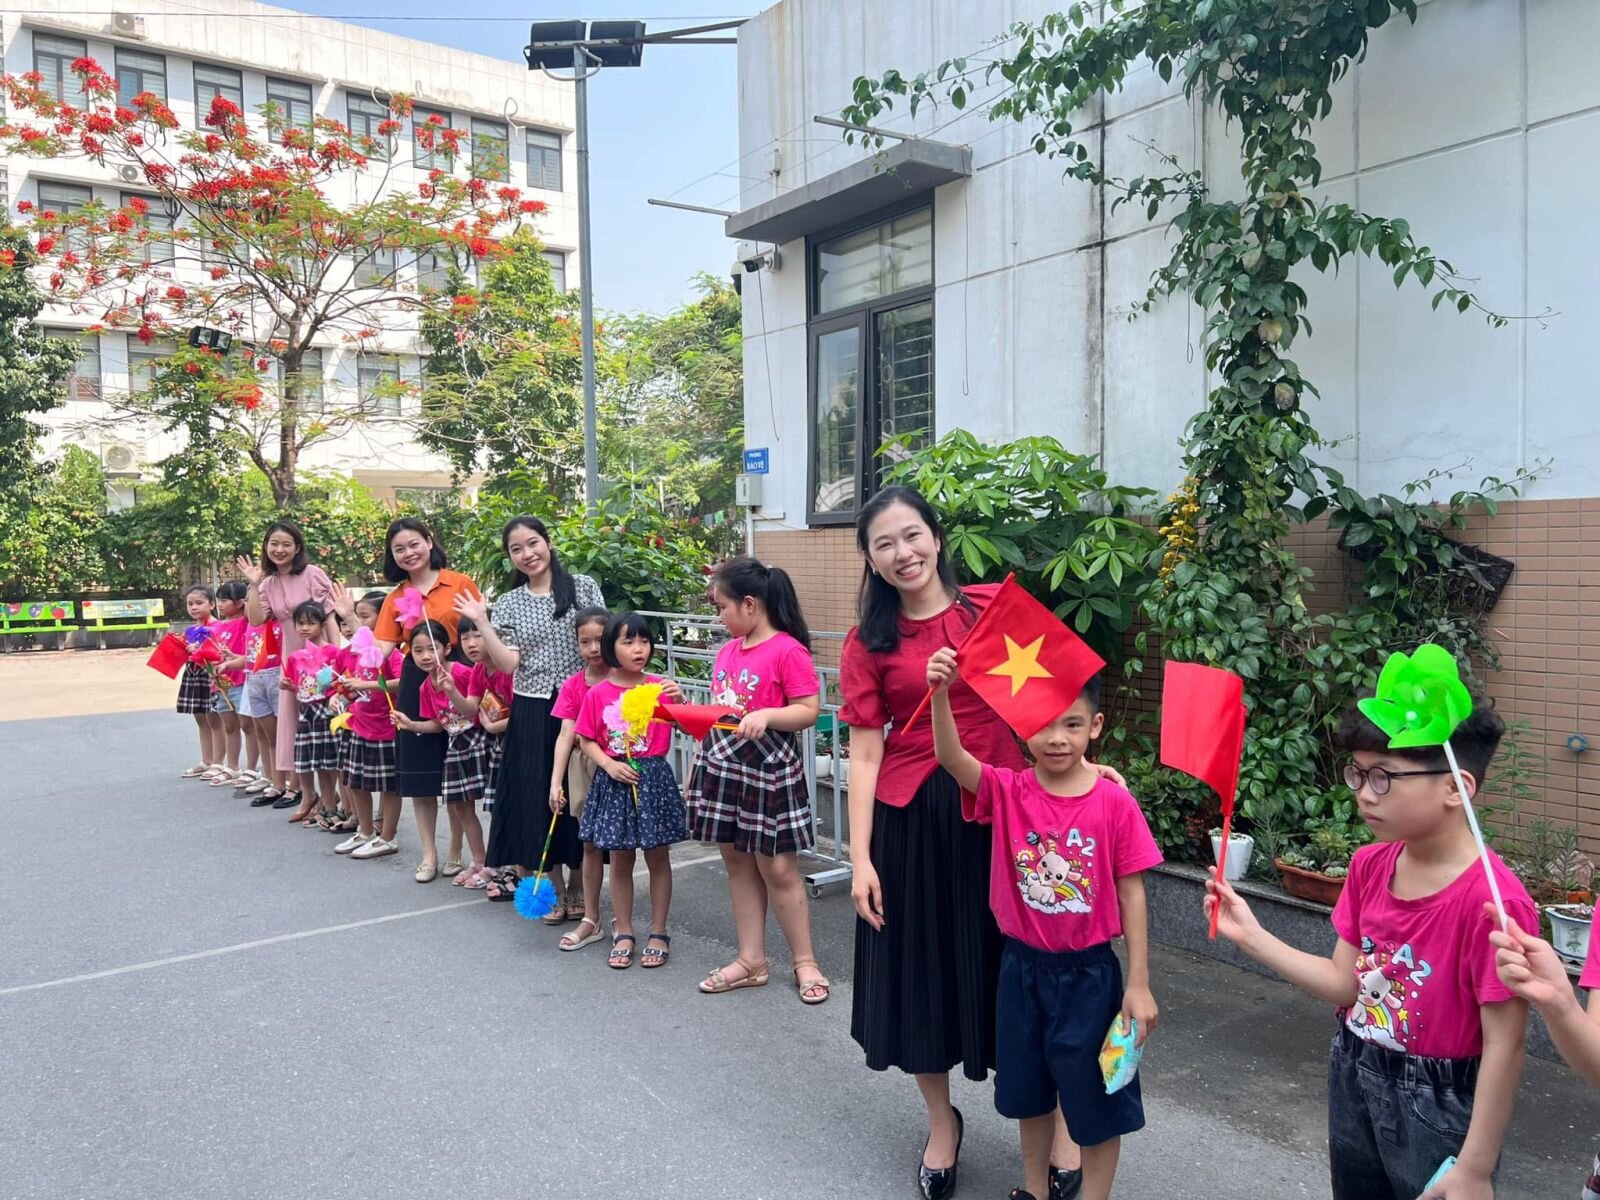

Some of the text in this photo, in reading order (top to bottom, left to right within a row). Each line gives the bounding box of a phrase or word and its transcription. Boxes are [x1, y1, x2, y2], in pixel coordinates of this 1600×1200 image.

[738, 668, 760, 692] A2
[1065, 827, 1097, 858] A2
[1391, 942, 1433, 987] A2
